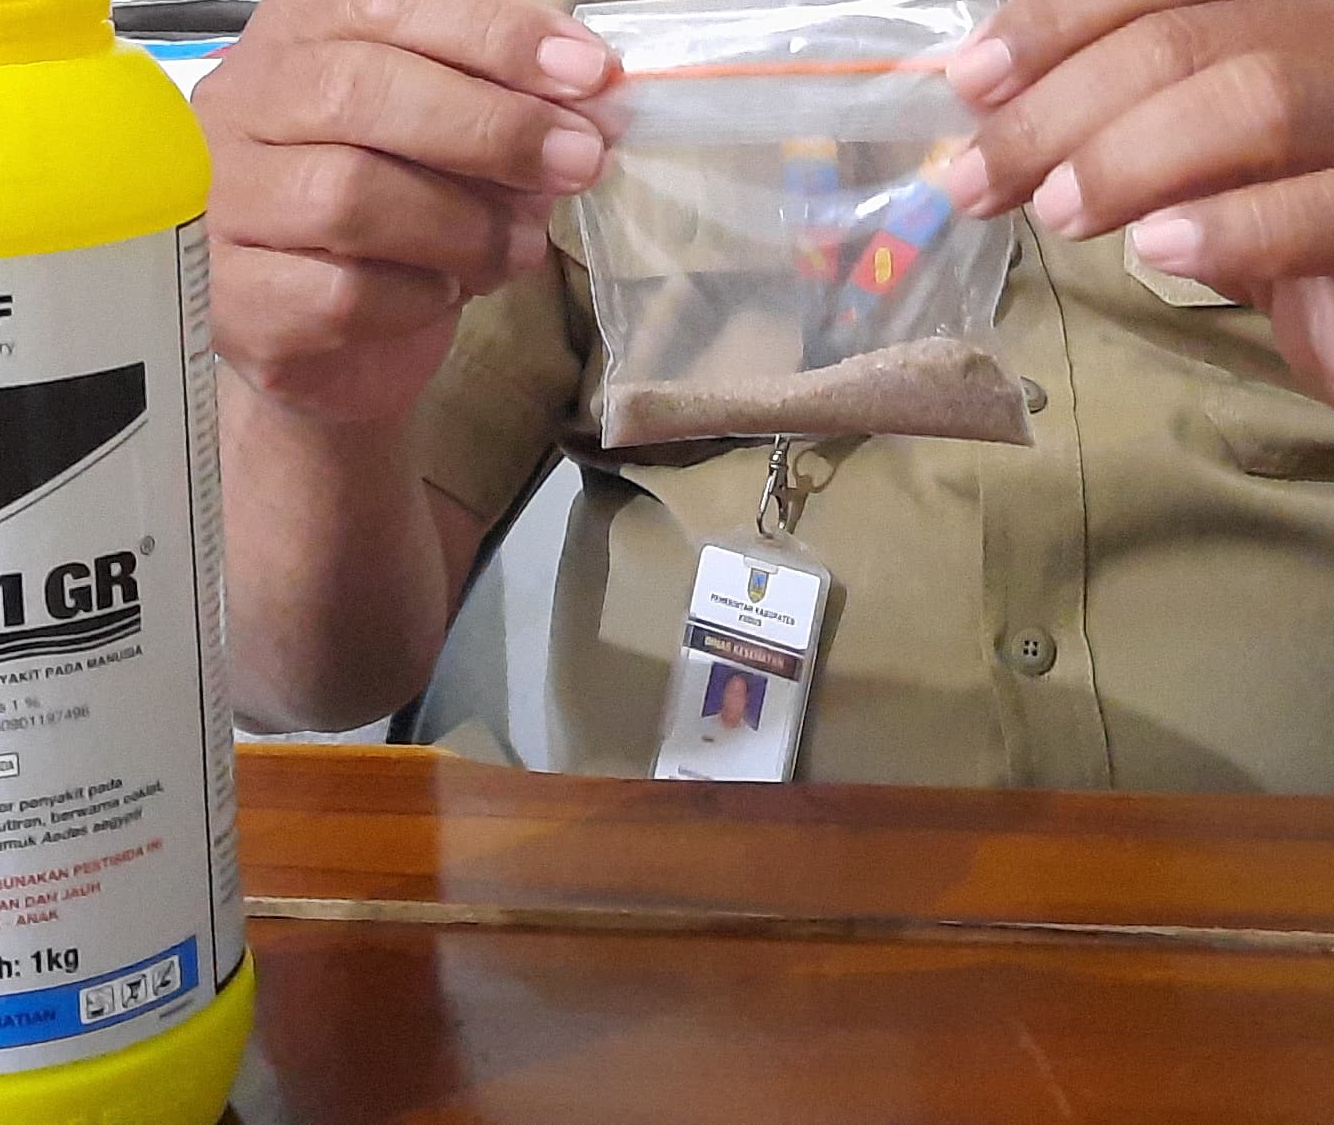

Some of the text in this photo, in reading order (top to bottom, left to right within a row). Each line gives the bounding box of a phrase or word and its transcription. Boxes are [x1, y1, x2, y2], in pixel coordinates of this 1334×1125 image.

[44, 550, 140, 620] GR
[46, 661, 84, 679] PADA
[19, 787, 84, 813] penyakit
[88, 778, 123, 800] pada
[24, 891, 58, 908] DAN
[61, 882, 101, 901] JAUH
[16, 909, 60, 926] ANAK
[30, 947, 80, 974] 1kg
